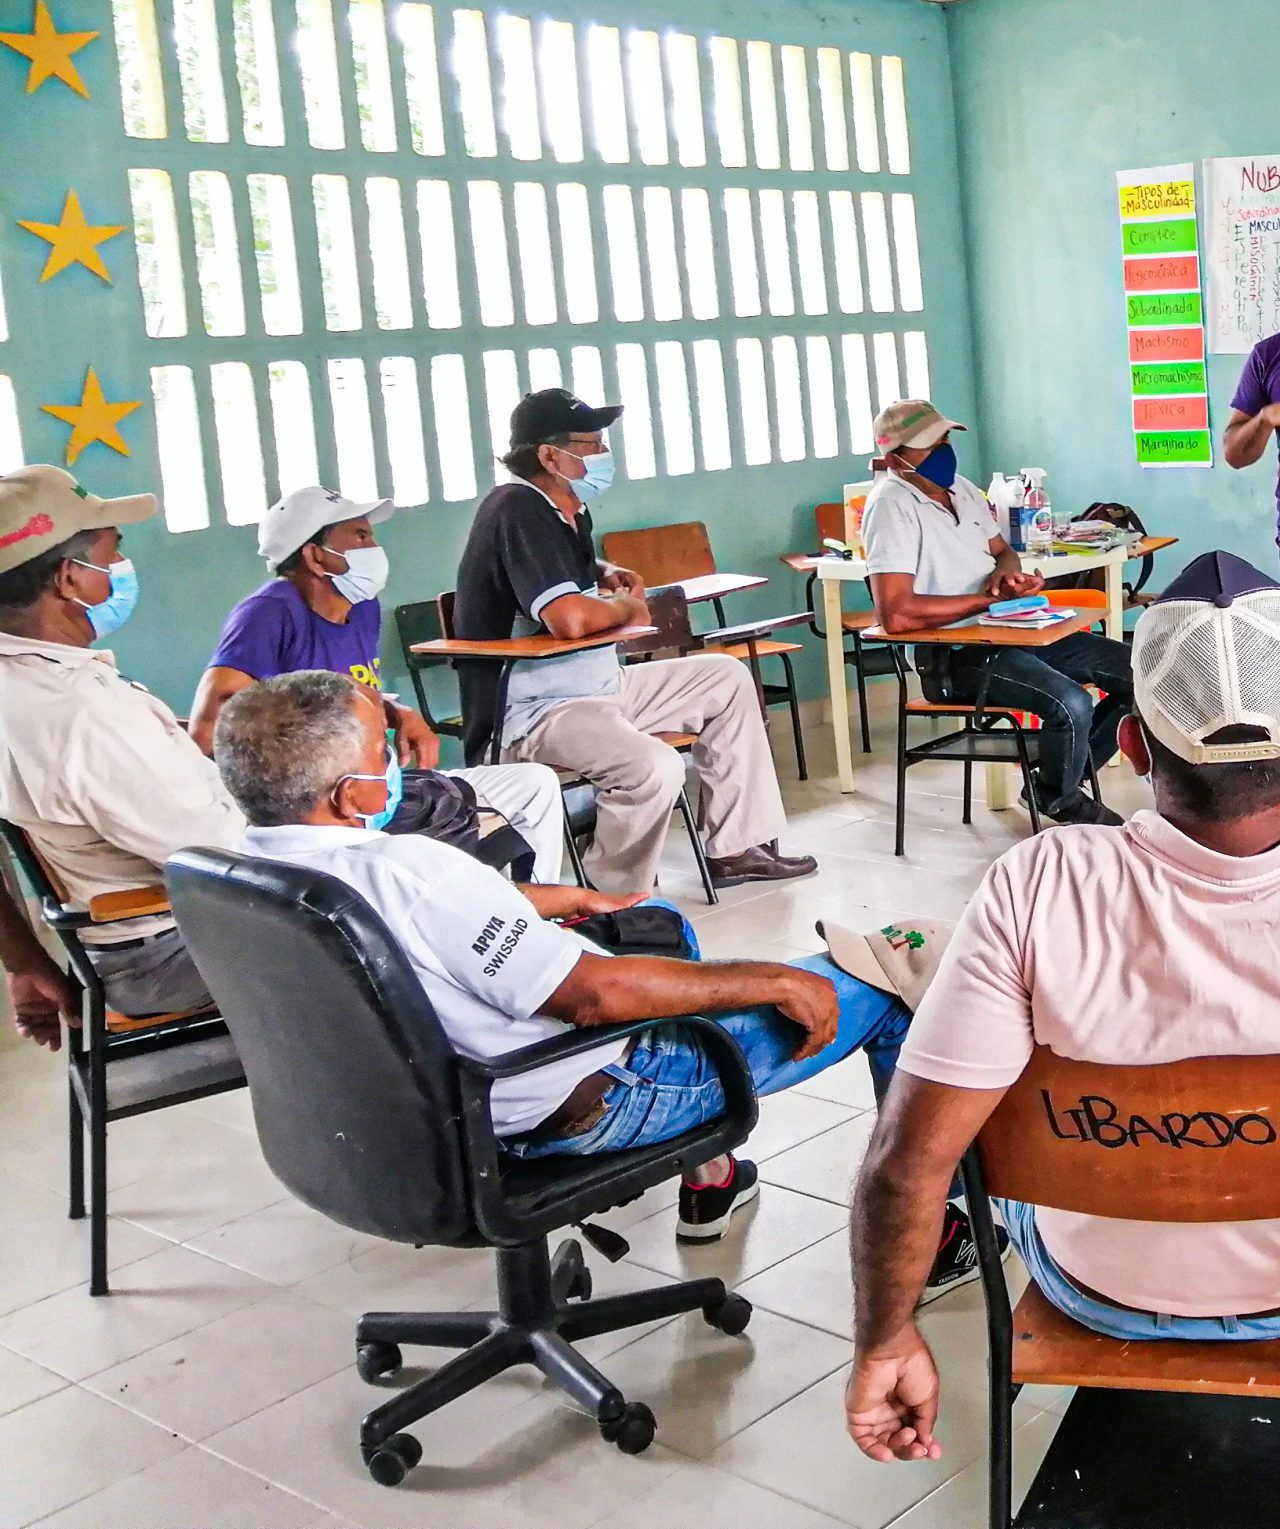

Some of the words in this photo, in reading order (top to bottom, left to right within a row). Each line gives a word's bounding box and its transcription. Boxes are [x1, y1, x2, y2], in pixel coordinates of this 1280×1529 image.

[471, 915, 506, 957] APOYA
[483, 918, 528, 977] SWISSAID
[1040, 1088, 1277, 1149] LIBARDO
